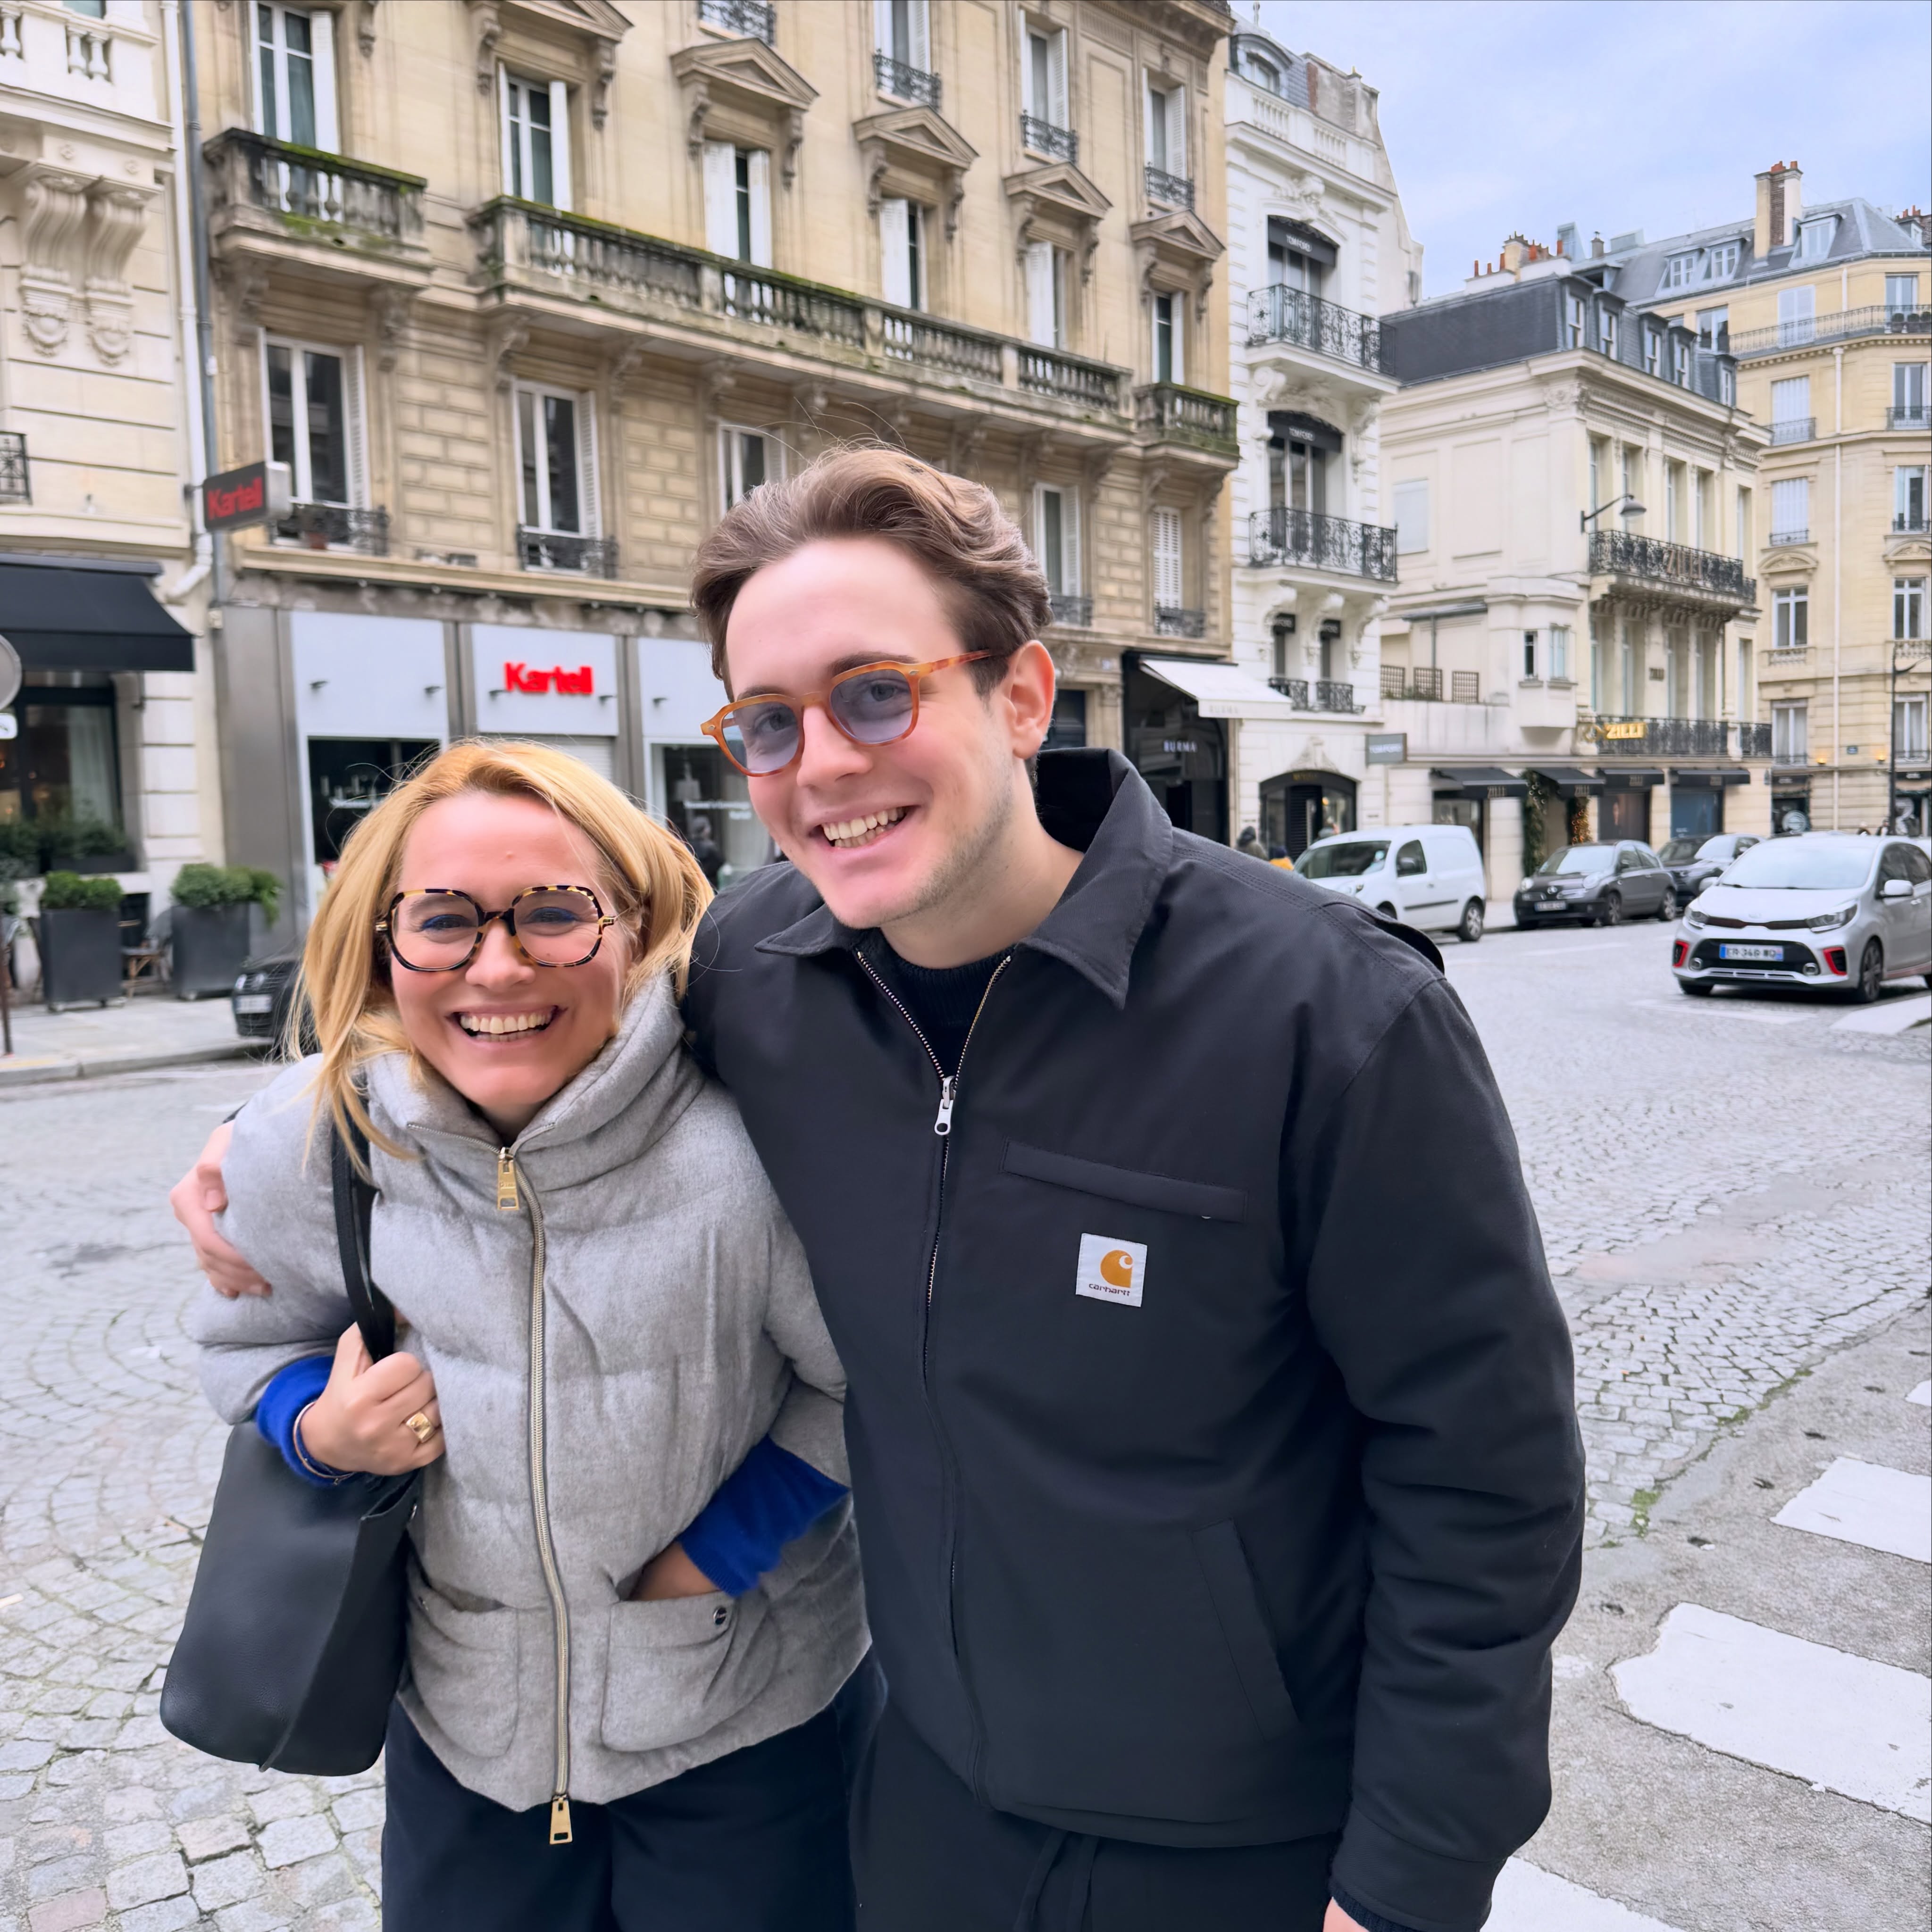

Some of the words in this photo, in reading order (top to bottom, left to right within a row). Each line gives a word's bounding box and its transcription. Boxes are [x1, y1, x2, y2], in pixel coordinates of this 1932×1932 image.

[207, 476, 263, 520] Kartell
[504, 662, 594, 694] Kartell
[1605, 722, 1645, 739] ZILLI
[1088, 1283, 1130, 1297] carhartt
